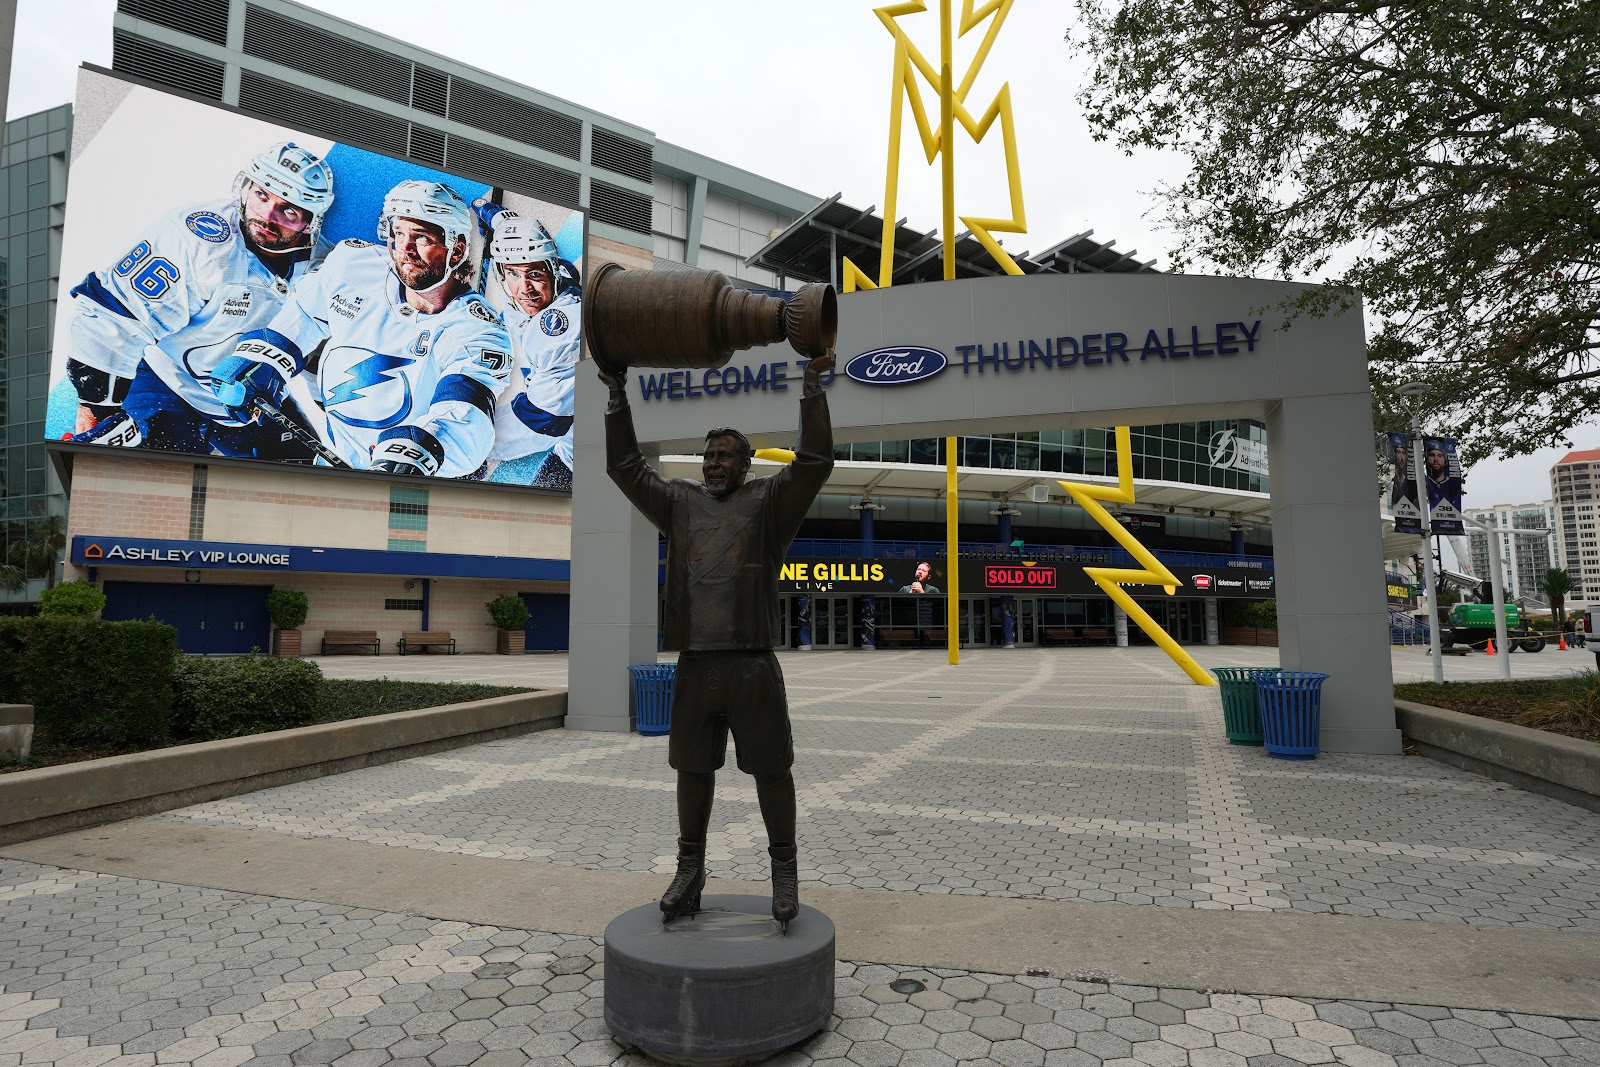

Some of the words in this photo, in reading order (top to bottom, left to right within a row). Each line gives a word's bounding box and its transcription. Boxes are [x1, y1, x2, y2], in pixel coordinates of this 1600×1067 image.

[280, 158, 302, 174] 86
[505, 226, 517, 234] 21
[114, 240, 181, 299] 86
[222, 307, 247, 317] Health
[224, 299, 250, 308] Advent
[330, 302, 355, 320] Health
[332, 294, 361, 313] Advent
[413, 329, 431, 357] C
[955, 332, 1130, 374] THUNDER
[1140, 320, 1262, 361] ALLEY
[639, 361, 788, 401] WELCOME
[865, 351, 926, 378] Ford
[384, 443, 435, 476] BAU
[106, 544, 195, 562] ASHLEY
[199, 550, 225, 563] VIP
[228, 552, 290, 566] LOUNGE
[940, 549, 1015, 560] RIAQUEST
[813, 563, 884, 582] GILLIS
[988, 569, 1025, 584] SOLD
[1027, 570, 1053, 585] OUT
[796, 582, 834, 590] LIVE
